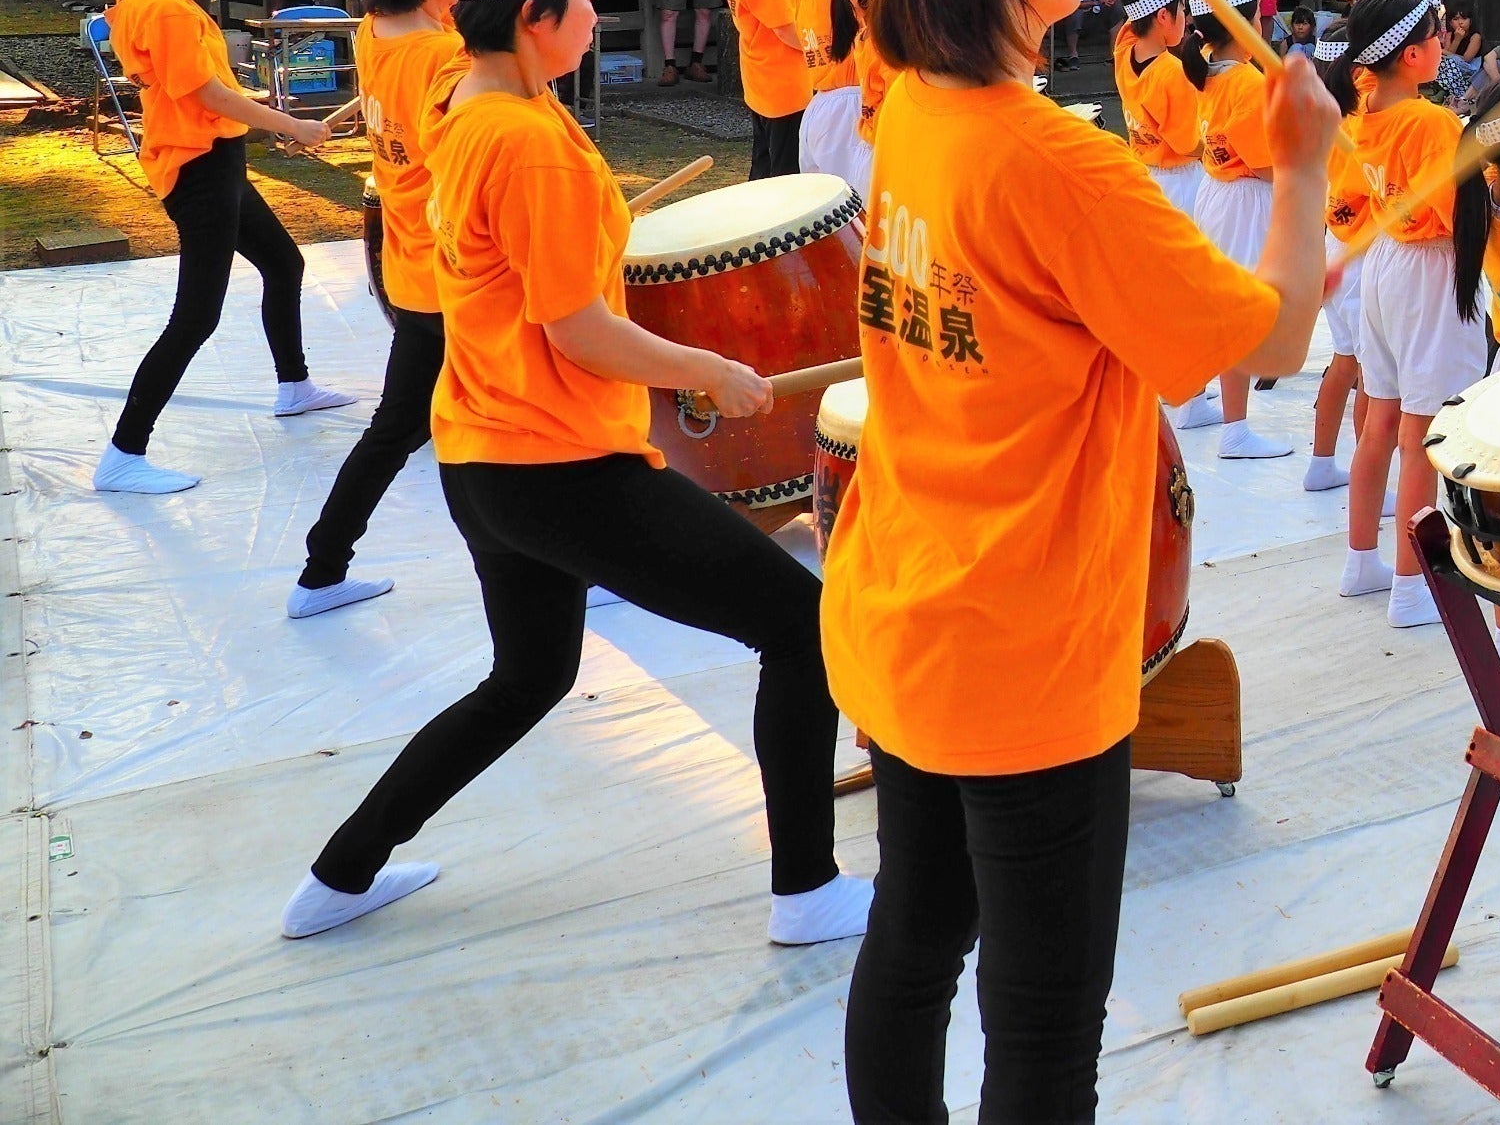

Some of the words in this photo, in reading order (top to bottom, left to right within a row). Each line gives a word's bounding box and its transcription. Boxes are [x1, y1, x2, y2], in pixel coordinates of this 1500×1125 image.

[866, 190, 929, 290] 300
[929, 258, 979, 306] 年祭
[860, 264, 985, 365] 室温泉
